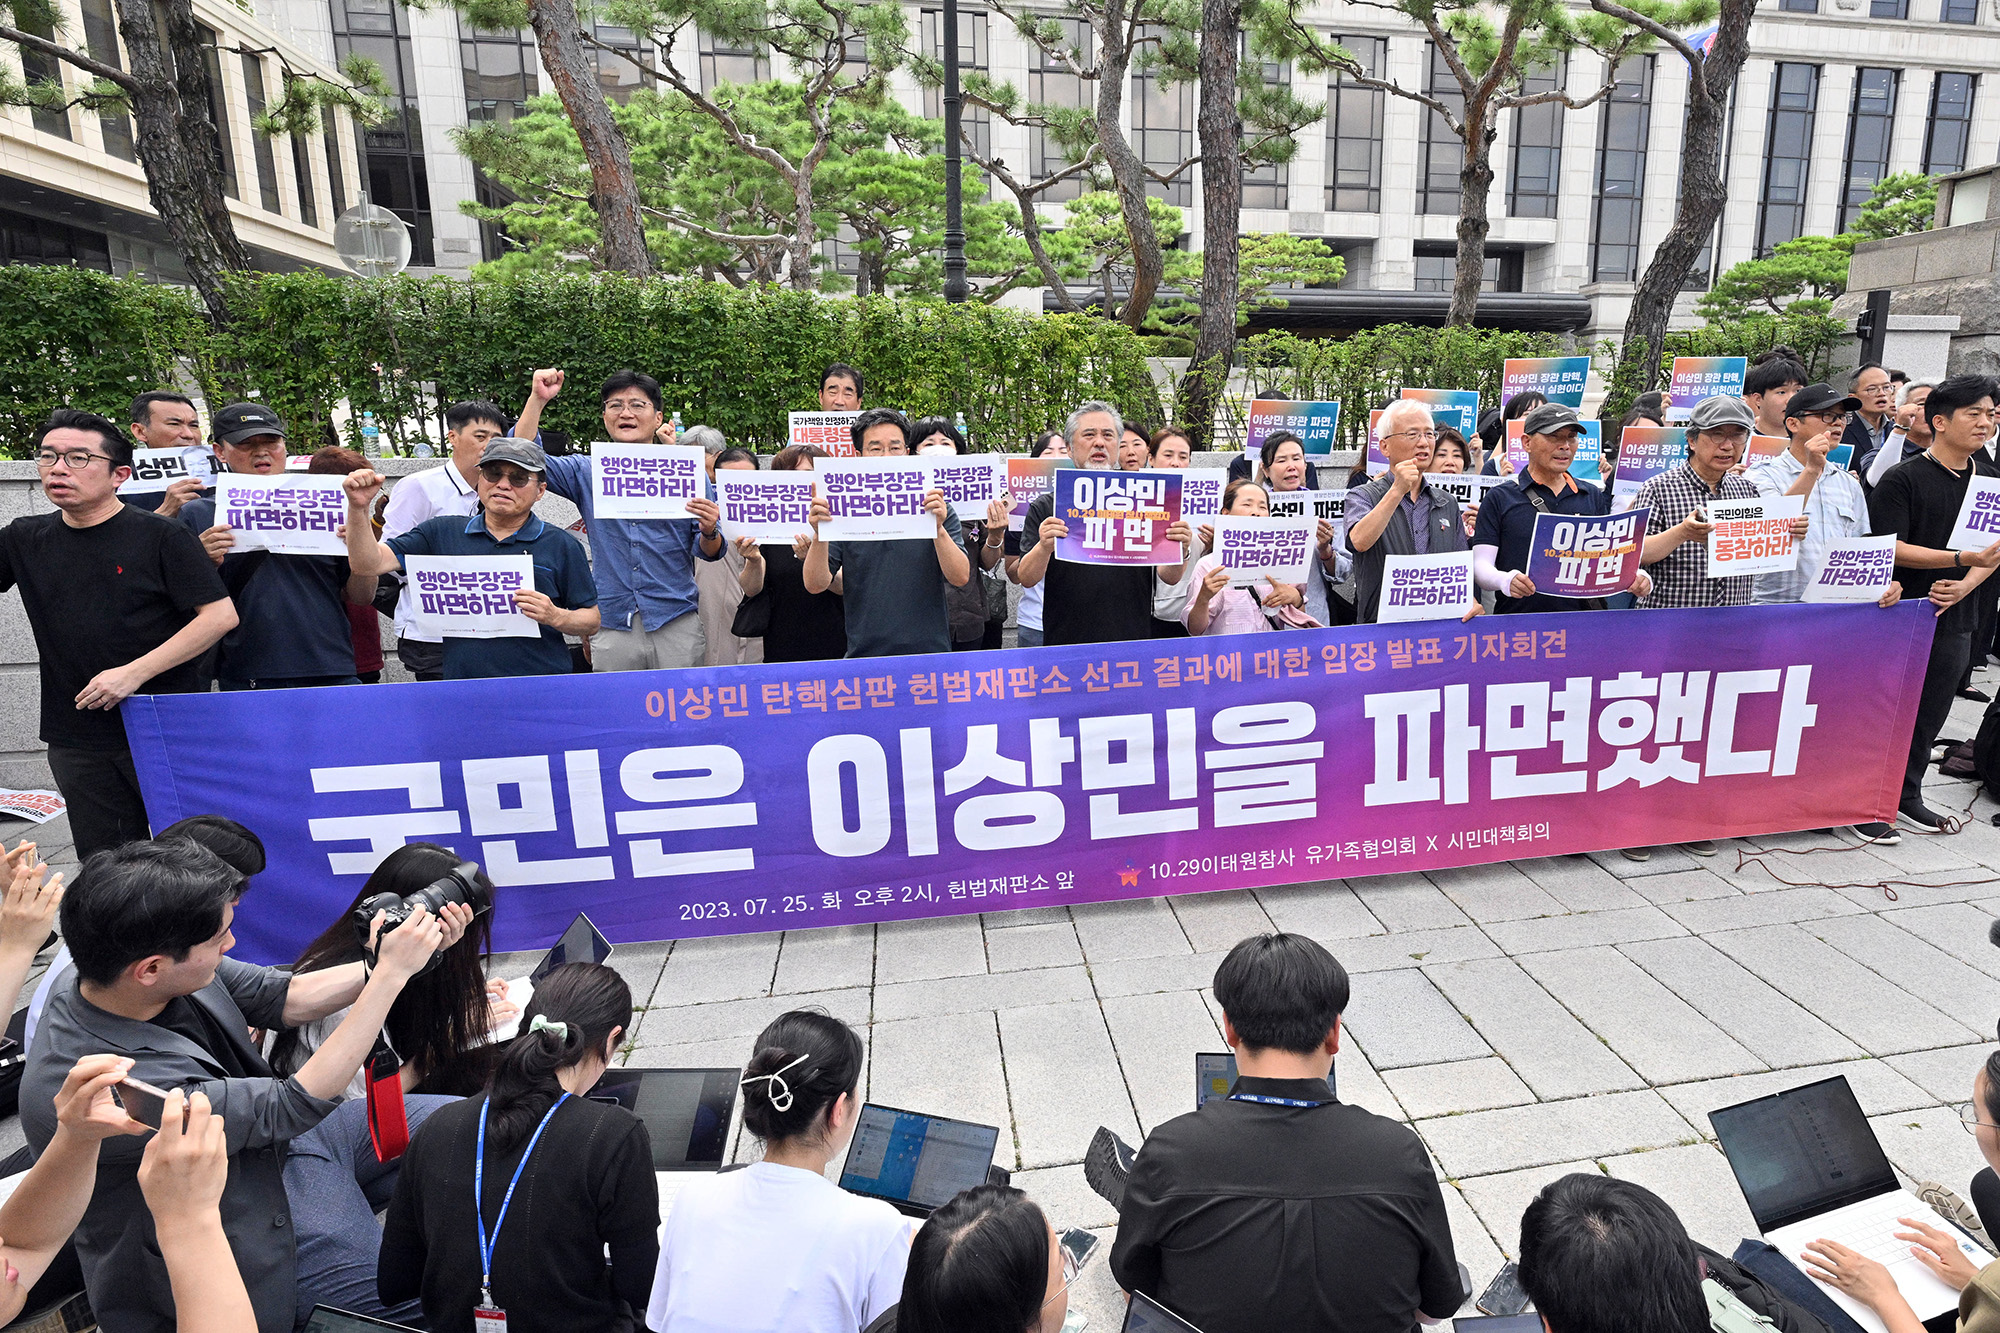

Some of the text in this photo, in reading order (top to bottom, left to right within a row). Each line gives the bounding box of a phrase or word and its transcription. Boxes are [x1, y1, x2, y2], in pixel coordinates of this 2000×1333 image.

[1508, 372, 1583, 383] 이상민 장관 탄핵,
[1677, 372, 1740, 383] 이상민 장관 탄핵,
[1504, 385, 1524, 395] 국민
[1548, 383, 1584, 394] 실현이다
[1672, 385, 1742, 396] 국민 상식 실현이다
[793, 416, 857, 426] 국가책임 인정하고
[1252, 415, 1333, 428] 이상민 장관 파면,
[793, 427, 853, 443] 대통령은
[1309, 429, 1330, 440] 시작
[1626, 443, 1659, 455] 이상민
[1661, 444, 1681, 455] 장관
[600, 456, 697, 477] 행안부장관
[1620, 457, 1642, 468] 국민
[1645, 458, 1666, 469] 상식
[602, 477, 696, 498] 파면하라!
[724, 483, 813, 502] 행안부장관
[824, 471, 925, 493] 행안부장관
[1011, 476, 1048, 488] 이상민
[227, 487, 345, 509] 행안부장관
[1073, 477, 1166, 513] 이상민
[726, 503, 812, 524] 파면하라
[826, 494, 926, 518] 파면하라!
[1067, 508, 1095, 518] 10.29
[1714, 507, 1763, 520] 국민의힘은
[1222, 529, 1309, 548] 행안부장관
[1551, 515, 1636, 552] 이상민
[1715, 518, 1796, 538] 특별법제정에
[1220, 547, 1305, 569] 파면하라!
[1543, 549, 1573, 558] 10.29
[1715, 535, 1793, 562] 동참하라!
[416, 570, 523, 592] 행안부장관
[1391, 565, 1468, 586] 행안부장관
[420, 593, 524, 615] 파면하라
[1388, 584, 1468, 606] 파면하라!
[645, 629, 1567, 721] 이상민 탄핵심판 헌법재판소 선고 결과에 대한 입장 발표 기자회견
[308, 665, 1818, 887] 국민은 이상민을 파면했다
[1149, 821, 1550, 879] 10.29이태원참사 유가족협의회 X 시민대책회의
[679, 870, 1075, 921] 2023. 07. 25. 화 오후 2시, 헌법재판소 앞
